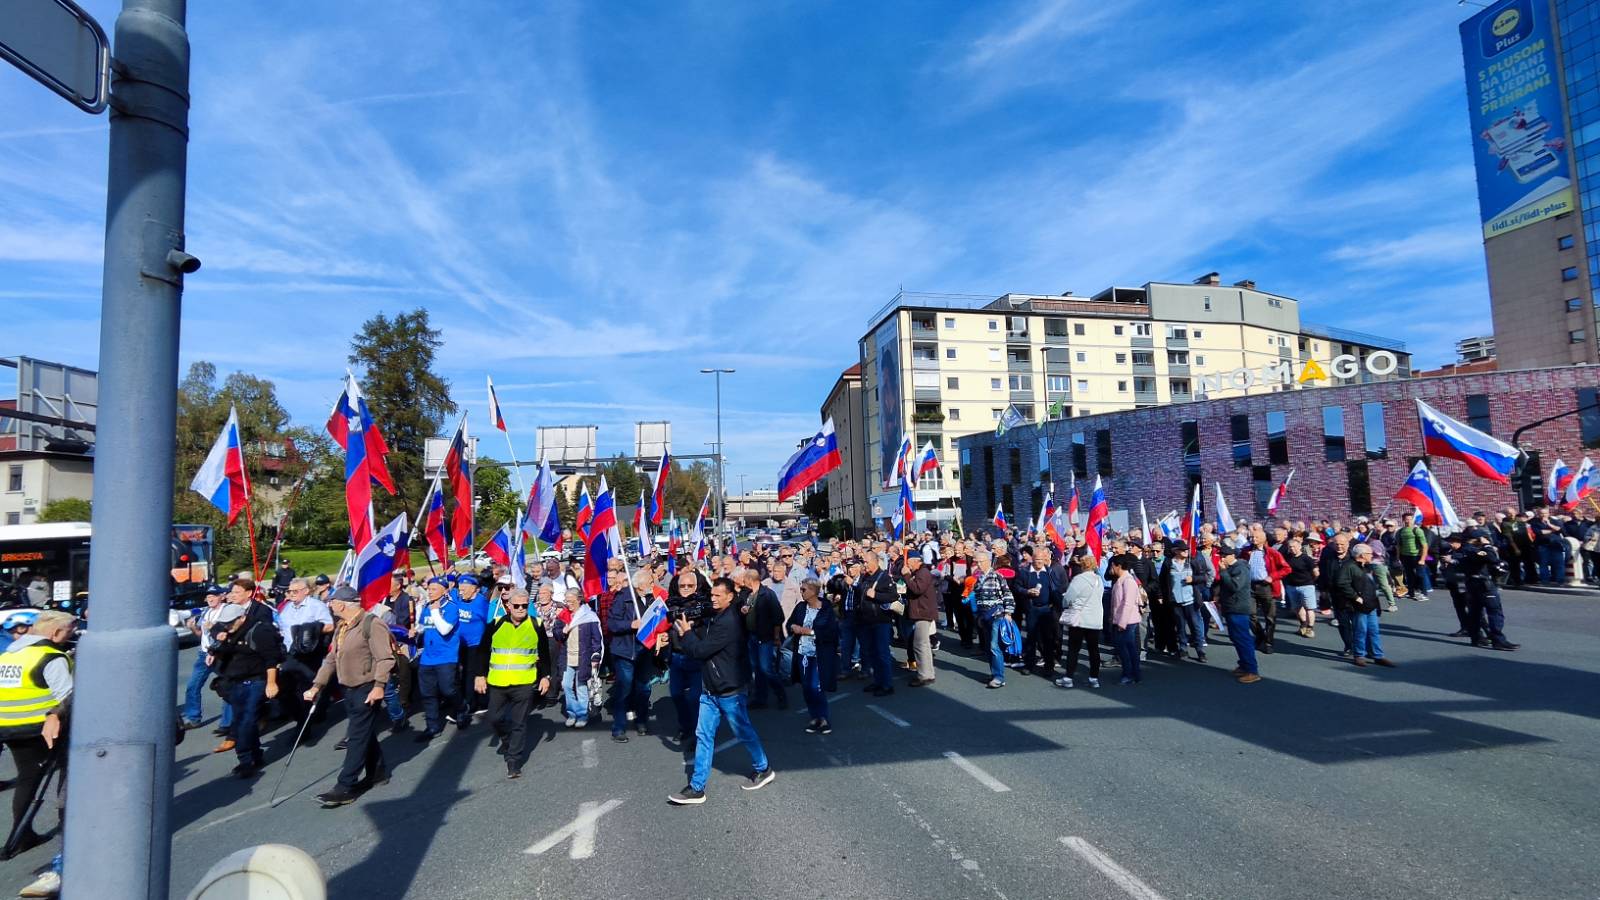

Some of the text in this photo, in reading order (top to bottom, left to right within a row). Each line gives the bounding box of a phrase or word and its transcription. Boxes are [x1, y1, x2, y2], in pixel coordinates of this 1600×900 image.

[1478, 39, 1545, 81] S PLUSOM
[1495, 33, 1520, 51] Plus
[1480, 51, 1545, 92] NA DLANI
[1481, 63, 1547, 104] SE VEDNO
[1480, 73, 1552, 116] PRIHRANI
[1491, 201, 1568, 232] lidl.si/lidl-plus
[1197, 350, 1397, 395] NOMAGO
[0, 665, 23, 679] RESS
